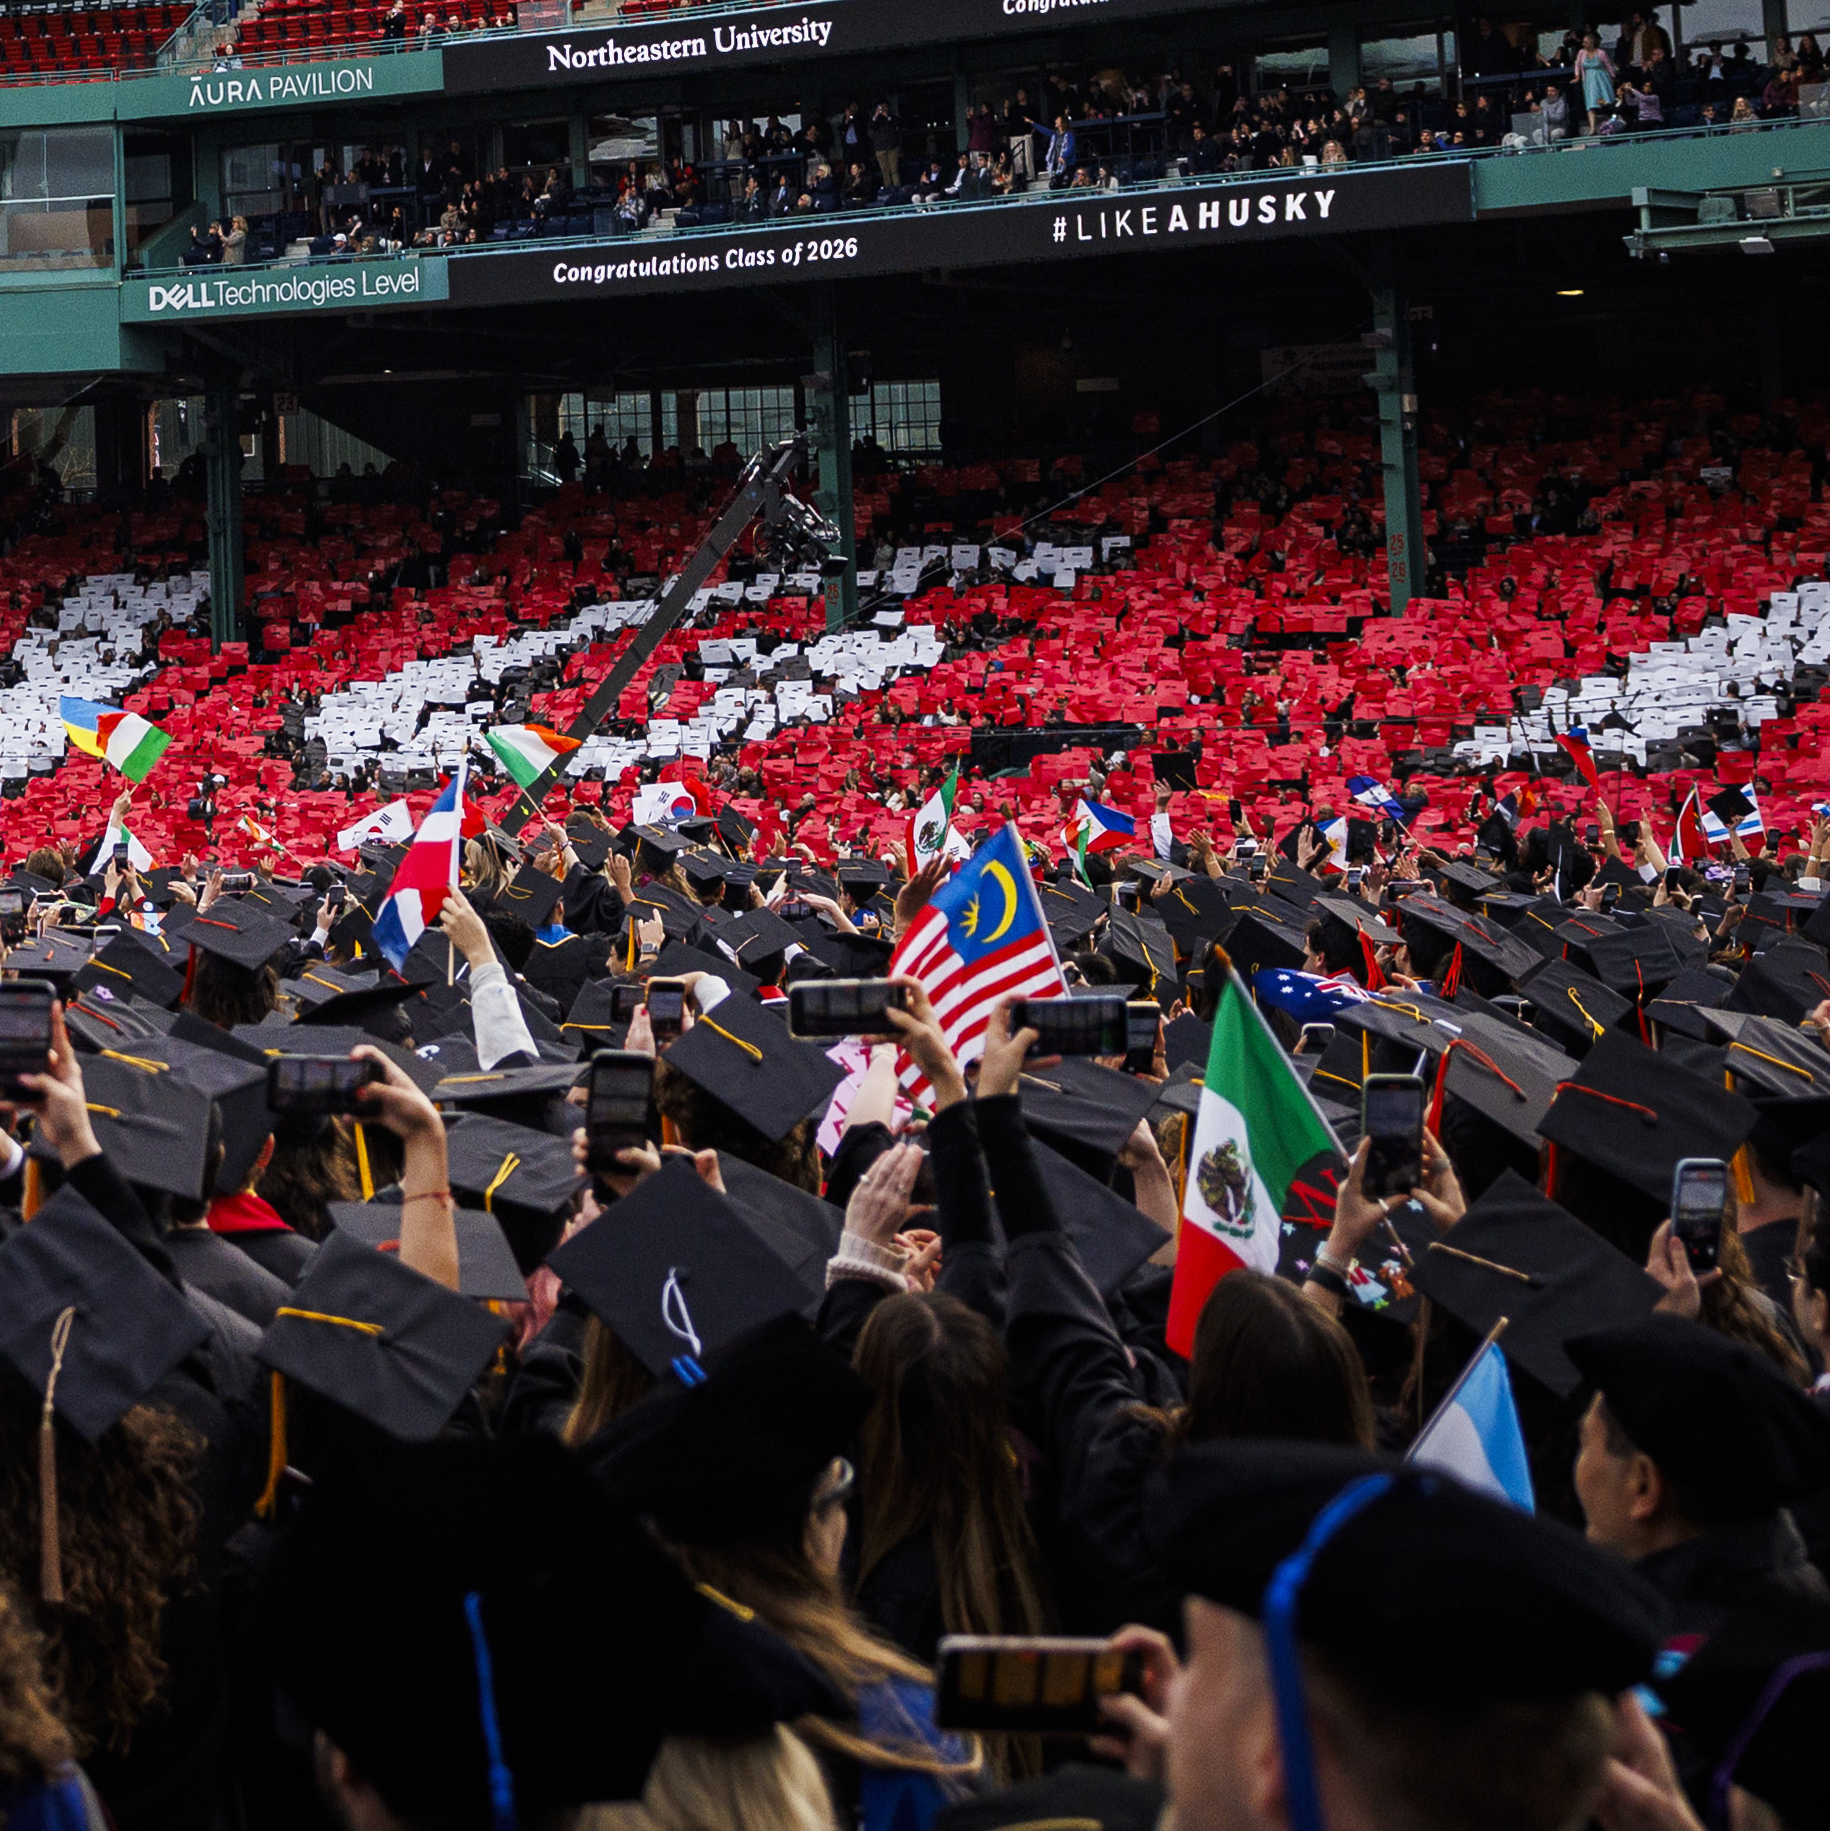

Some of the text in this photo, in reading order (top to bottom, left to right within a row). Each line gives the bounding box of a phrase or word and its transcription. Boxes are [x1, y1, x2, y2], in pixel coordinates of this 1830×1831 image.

[545, 16, 833, 71] Northeastern University
[269, 66, 373, 99] PAVILION
[553, 237, 858, 284] Congratulations Class of 2026
[215, 276, 356, 307] Technologies
[362, 265, 420, 296] Level
[277, 395, 293, 411] 23
[1390, 533, 1405, 551] 25
[1392, 561, 1407, 578] 26
